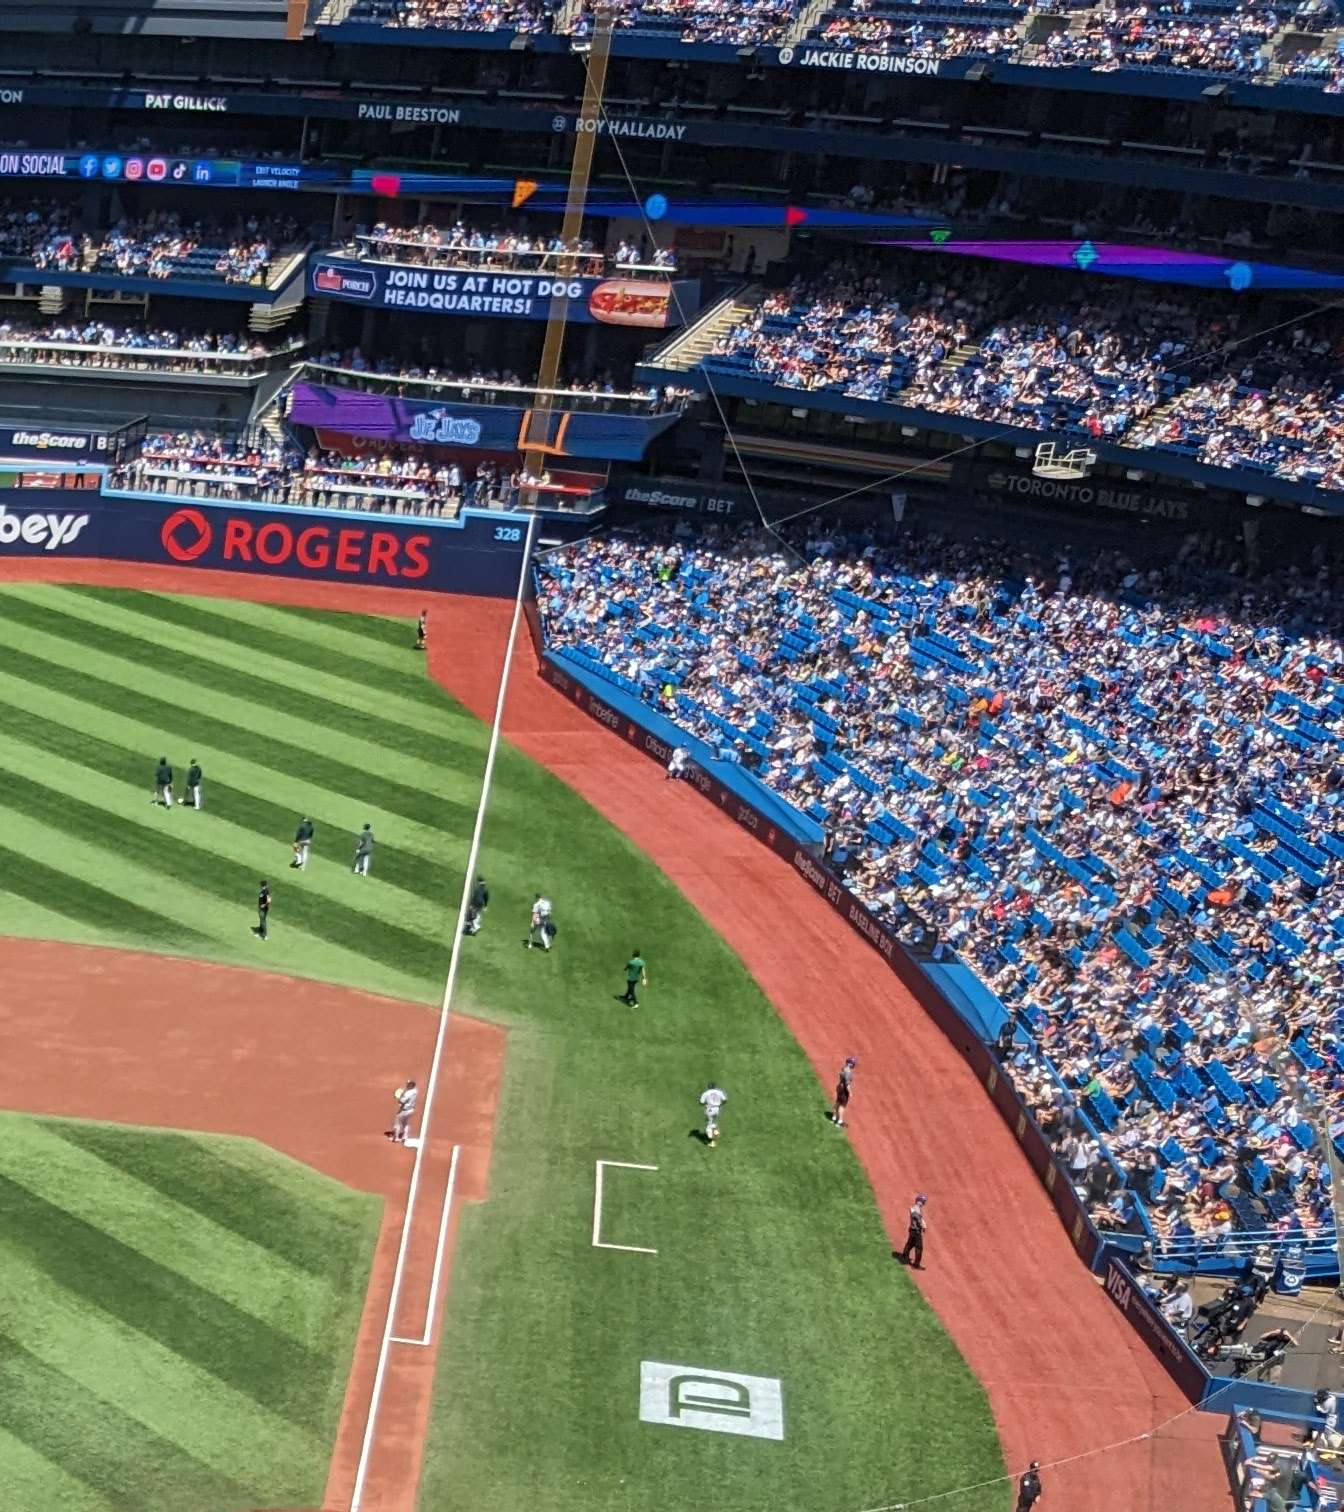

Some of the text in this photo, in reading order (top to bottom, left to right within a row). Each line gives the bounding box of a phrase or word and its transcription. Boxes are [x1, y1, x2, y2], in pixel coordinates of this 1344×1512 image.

[800, 50, 940, 76] JACKIE ROBINSON
[145, 94, 227, 112] PAT GILLICK
[358, 104, 460, 123] PAUL BEESTON
[575, 118, 687, 142] ROY HALLADAY
[0, 154, 19, 173] ON
[21, 154, 67, 175] SOCIAL
[385, 270, 583, 299] JOIN US AT HOT DOG
[384, 289, 532, 315] HEADQUARTERS!
[12, 431, 87, 450] theScore
[624, 488, 736, 515] theScore BET
[1008, 475, 1190, 521] TORONTO BLUE JAYS
[494, 526, 521, 542] 328
[223, 518, 433, 579] ROGERS
[825, 881, 842, 905] BET
[1106, 1263, 1132, 1311] VISA
